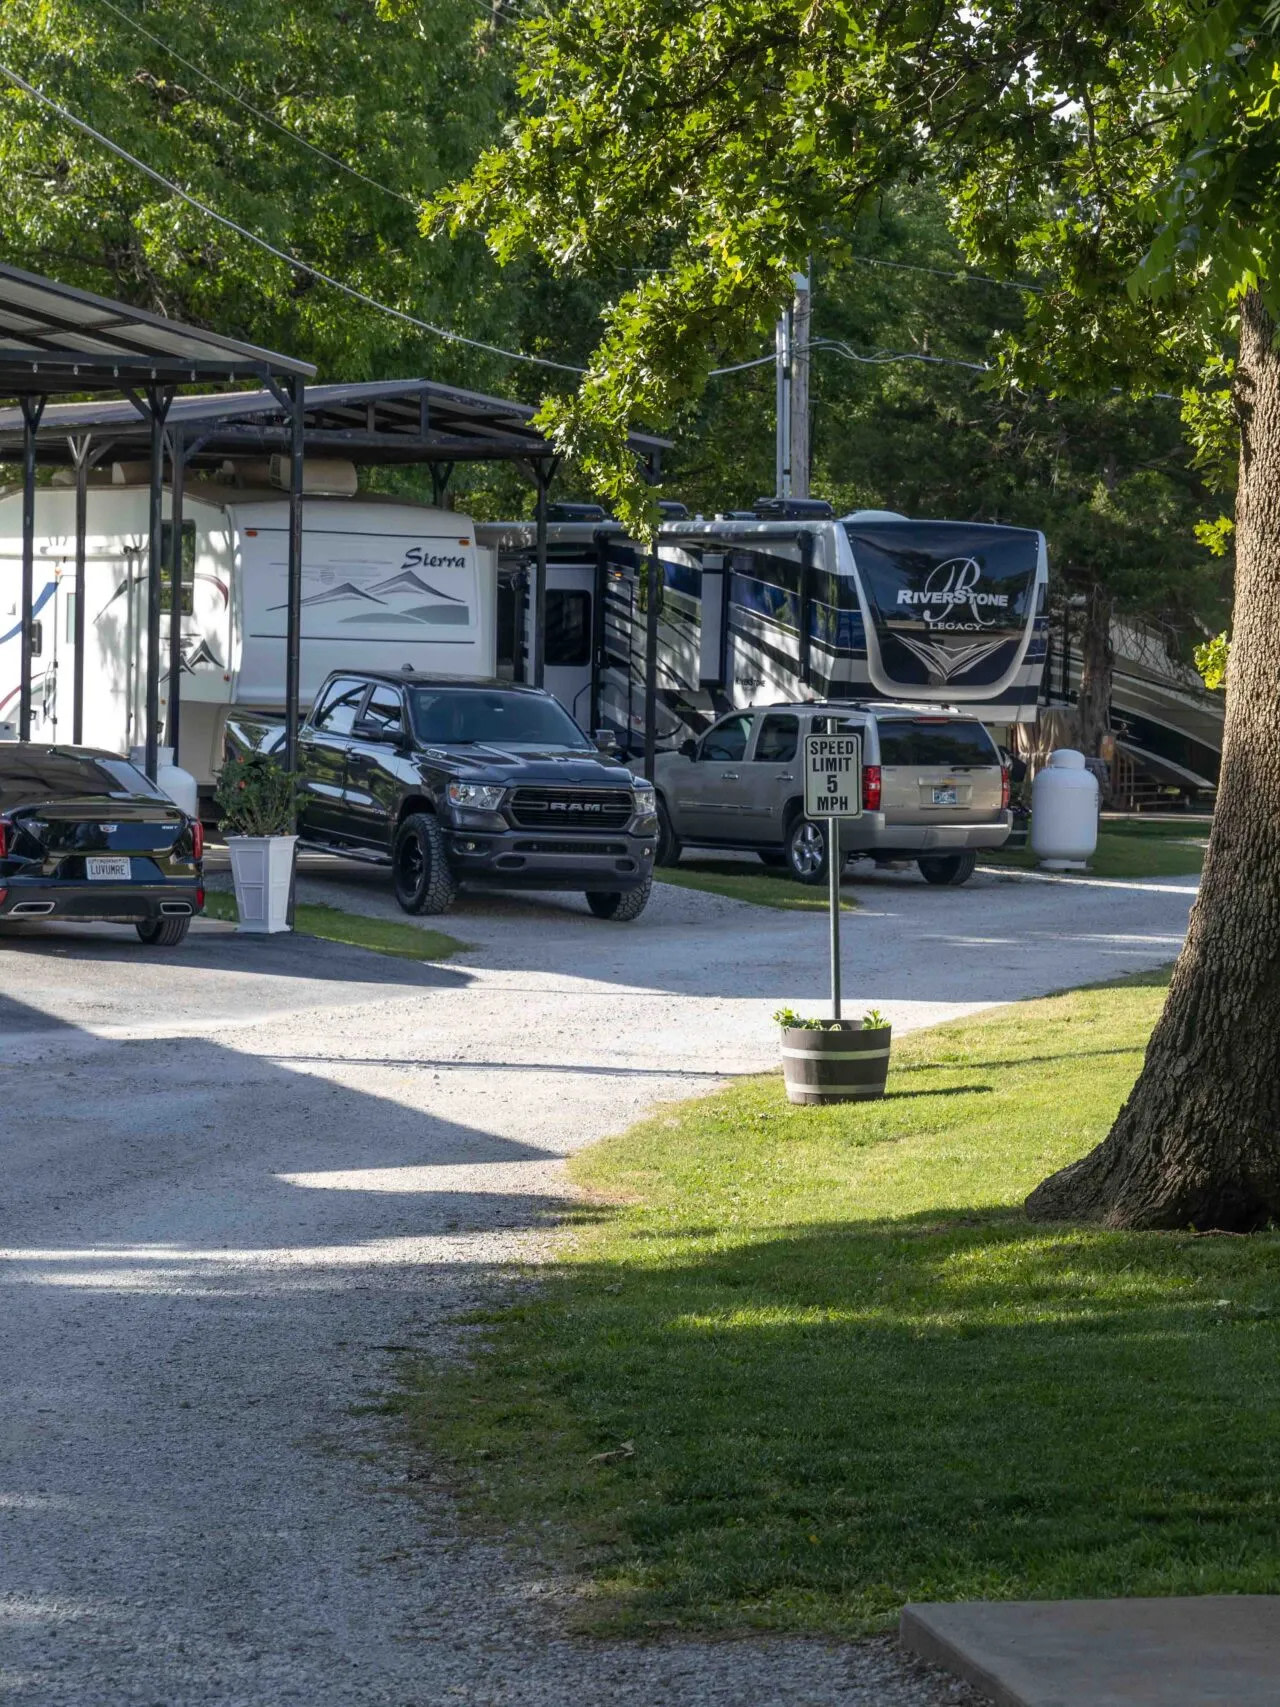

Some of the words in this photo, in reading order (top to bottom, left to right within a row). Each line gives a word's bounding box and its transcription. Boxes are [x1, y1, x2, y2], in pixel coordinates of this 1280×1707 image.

[400, 547, 466, 569] Sierra
[929, 622, 982, 631] LEGACY
[810, 740, 854, 755] SPEED
[812, 757, 852, 772] LIMIT
[827, 774, 838, 794] 5
[550, 802, 601, 812] RAM
[817, 796, 848, 811] MPH
[91, 864, 126, 875] LUVUMRE
